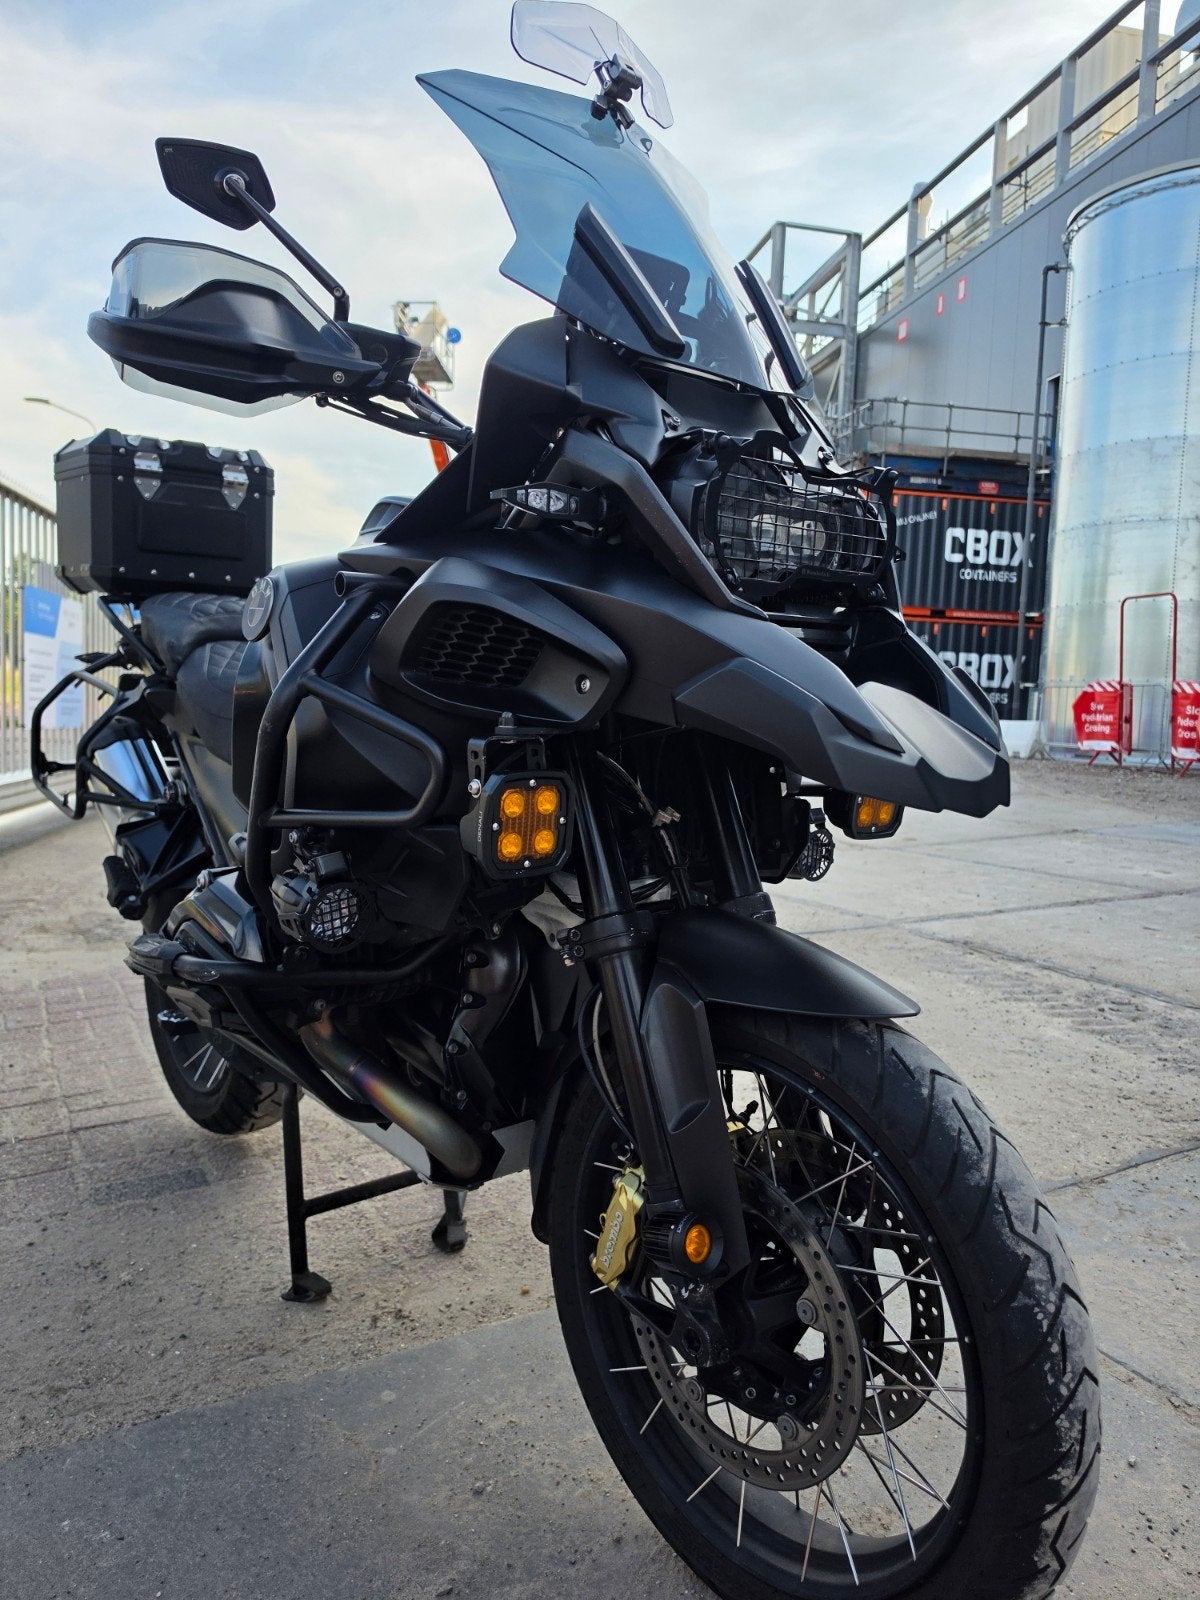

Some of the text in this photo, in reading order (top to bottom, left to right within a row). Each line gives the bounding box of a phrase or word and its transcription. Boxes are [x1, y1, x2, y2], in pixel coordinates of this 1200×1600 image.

[944, 527, 1035, 568] CBOX
[959, 568, 1018, 583] CONTAINERS
[600, 1210, 623, 1268] brembo
